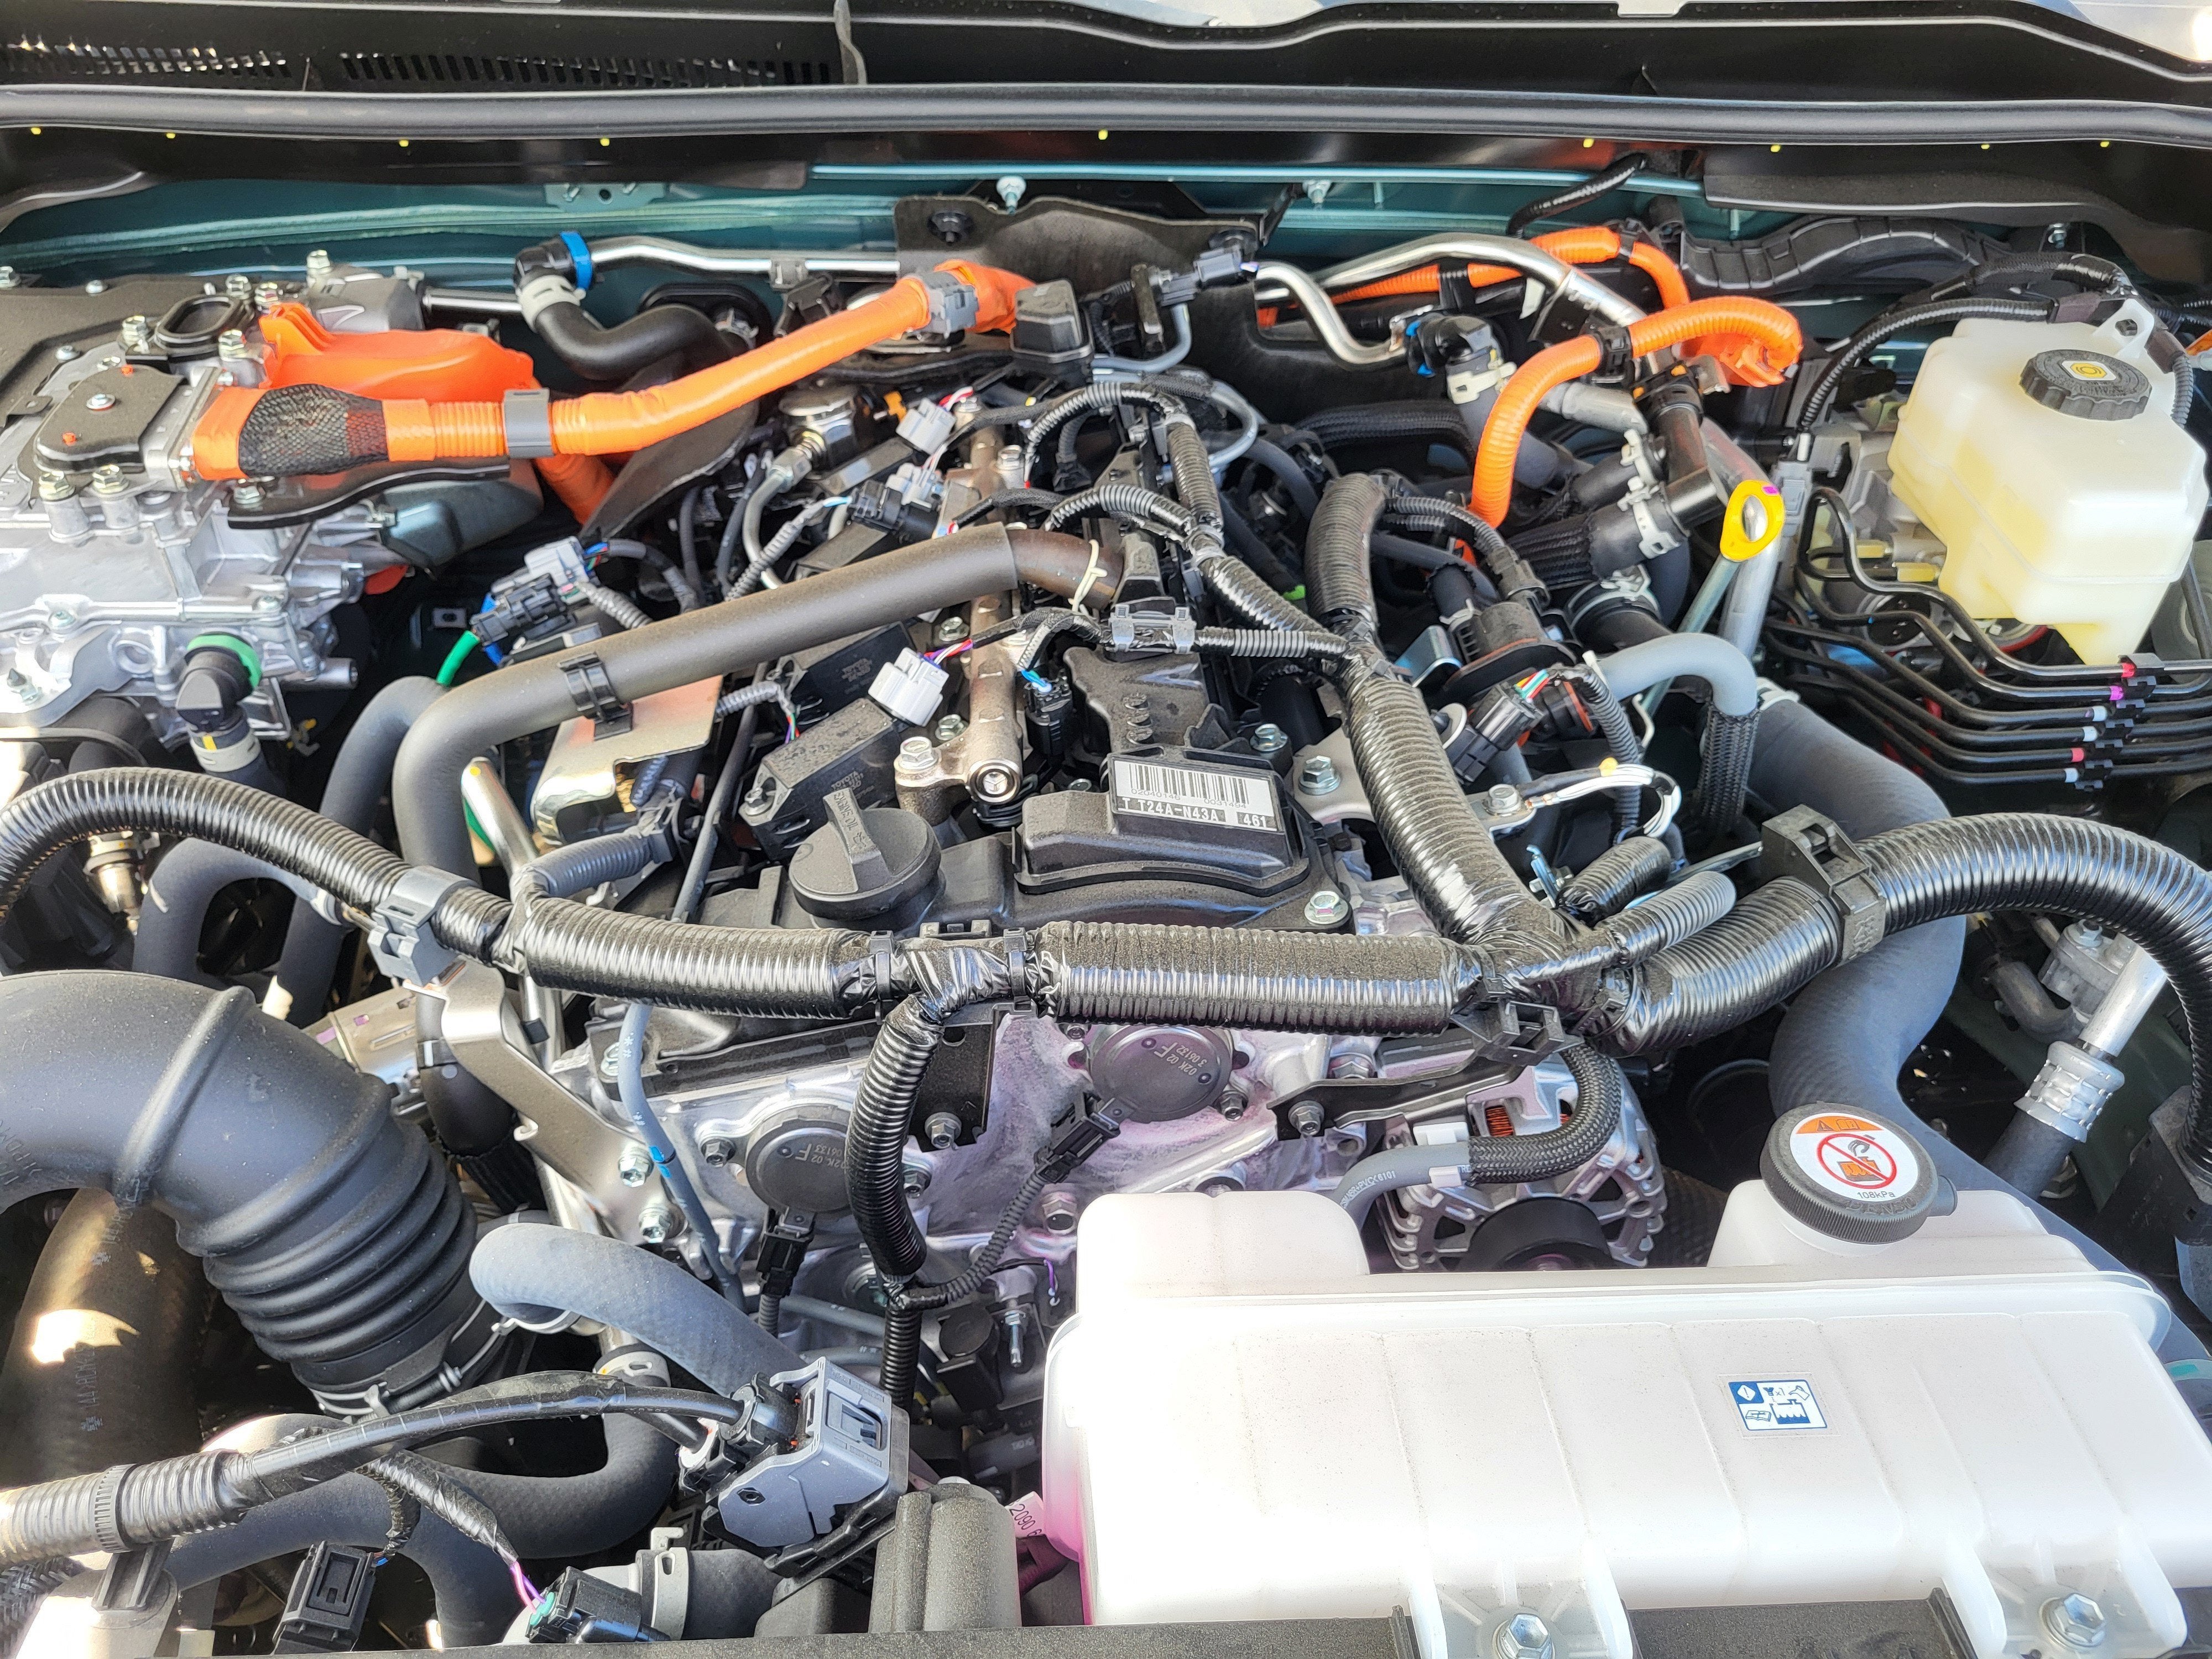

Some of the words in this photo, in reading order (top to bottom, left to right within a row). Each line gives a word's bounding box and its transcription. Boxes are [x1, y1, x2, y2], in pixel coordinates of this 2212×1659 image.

[834, 792, 853, 818] ENGINE
[846, 817, 859, 831] OIL
[1123, 797, 1131, 810] T
[1138, 799, 1219, 822] T24A-N43A
[1243, 816, 1267, 828] 461
[1154, 1042, 1178, 1058] F
[1176, 1045, 1201, 1063] 06132
[1166, 1053, 1180, 1065] 02
[1178, 1061, 1197, 1076] 02K
[795, 1143, 812, 1161] F
[811, 1155, 823, 1164] 02
[1857, 1191, 1896, 1199] 108kPa
[1009, 1499, 1036, 1531] 2090
